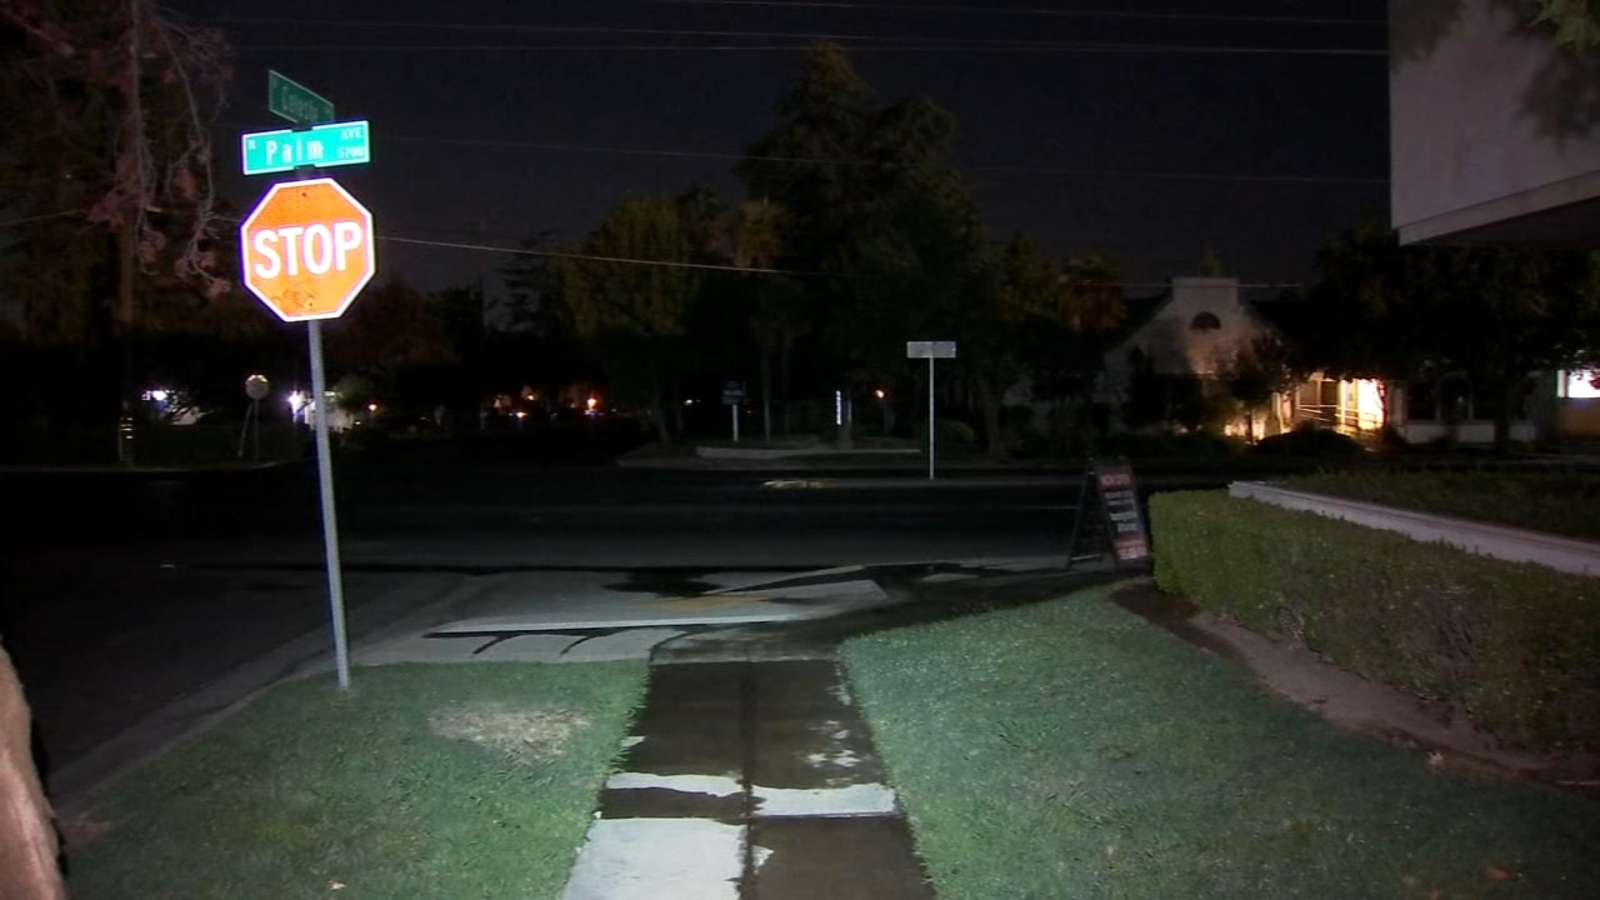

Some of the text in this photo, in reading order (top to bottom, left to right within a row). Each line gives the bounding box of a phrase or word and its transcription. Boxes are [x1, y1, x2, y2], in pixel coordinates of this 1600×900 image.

[266, 138, 324, 166] Palm
[340, 127, 362, 141] AVE
[253, 221, 362, 279] STOP
